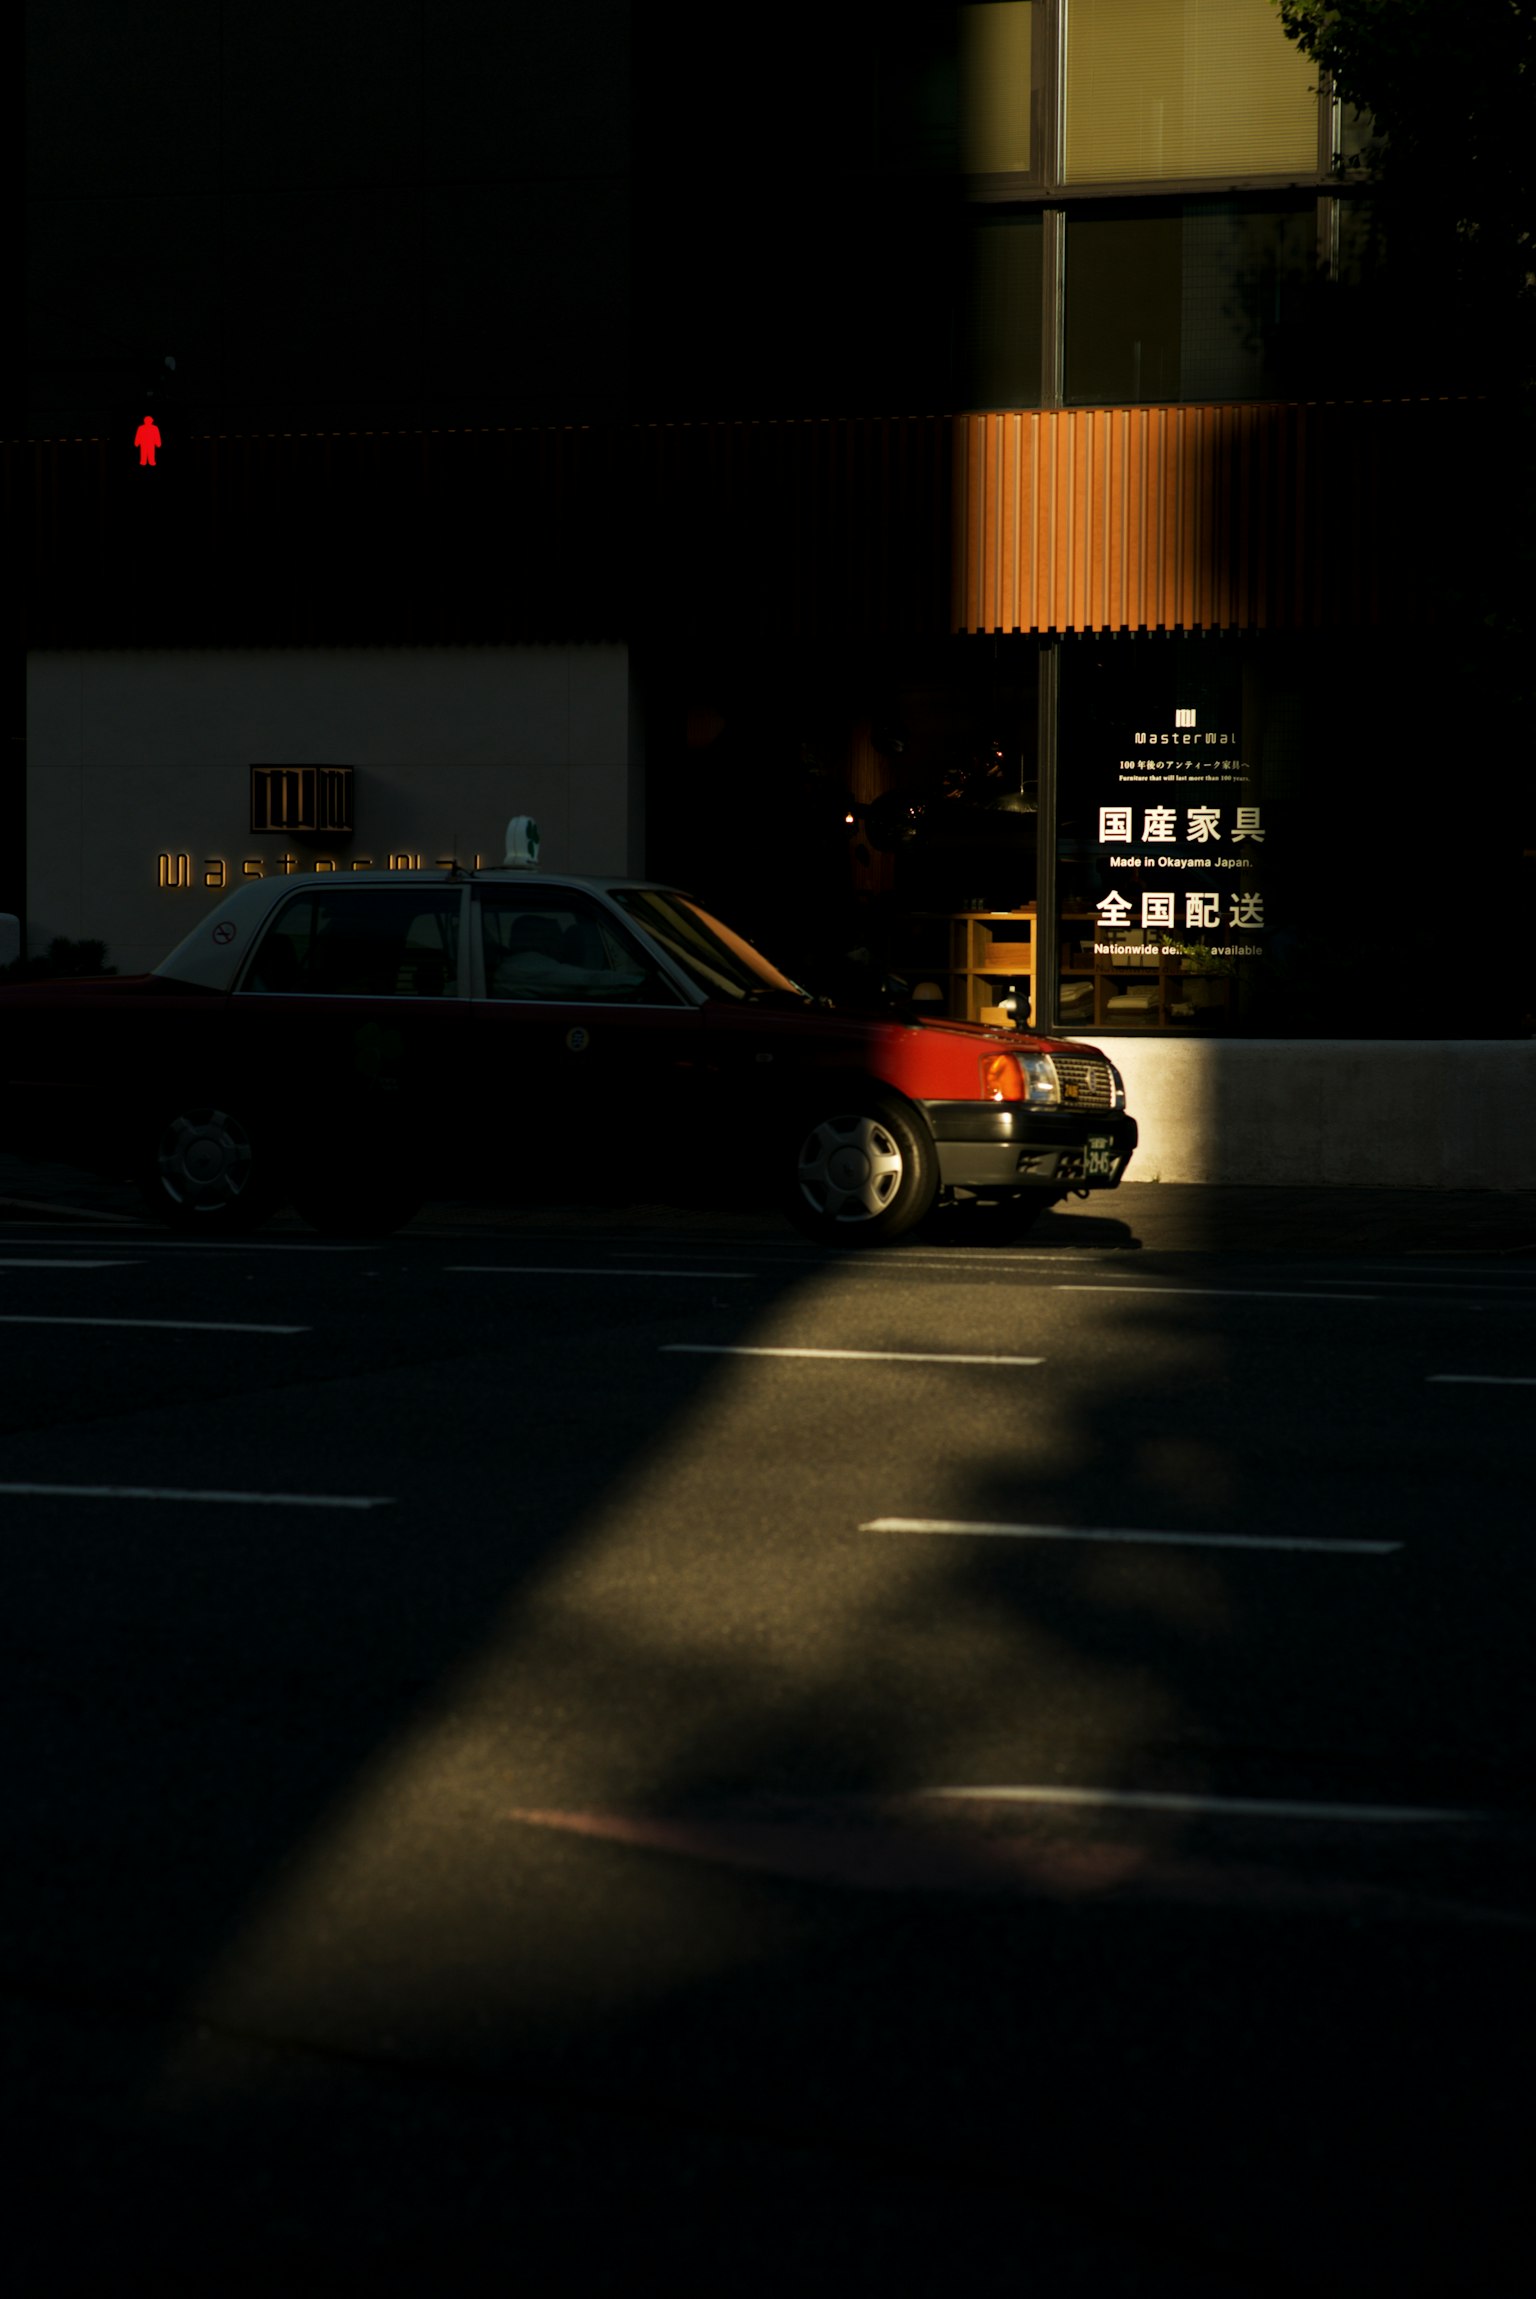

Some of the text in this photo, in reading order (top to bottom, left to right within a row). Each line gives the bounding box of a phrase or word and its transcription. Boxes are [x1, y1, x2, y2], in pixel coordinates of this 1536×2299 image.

[1149, 774, 1162, 782] that
[1163, 774, 1175, 782] will
[1176, 774, 1187, 782] last
[1205, 774, 1219, 782] than
[1221, 774, 1232, 782] 100
[1098, 805, 1266, 844] 国産家具
[1110, 857, 1253, 870] Made in Okayama Japan.
[1096, 889, 1264, 929] 全国配送
[1094, 943, 1159, 956] Nationwide
[1210, 945, 1263, 956] available
